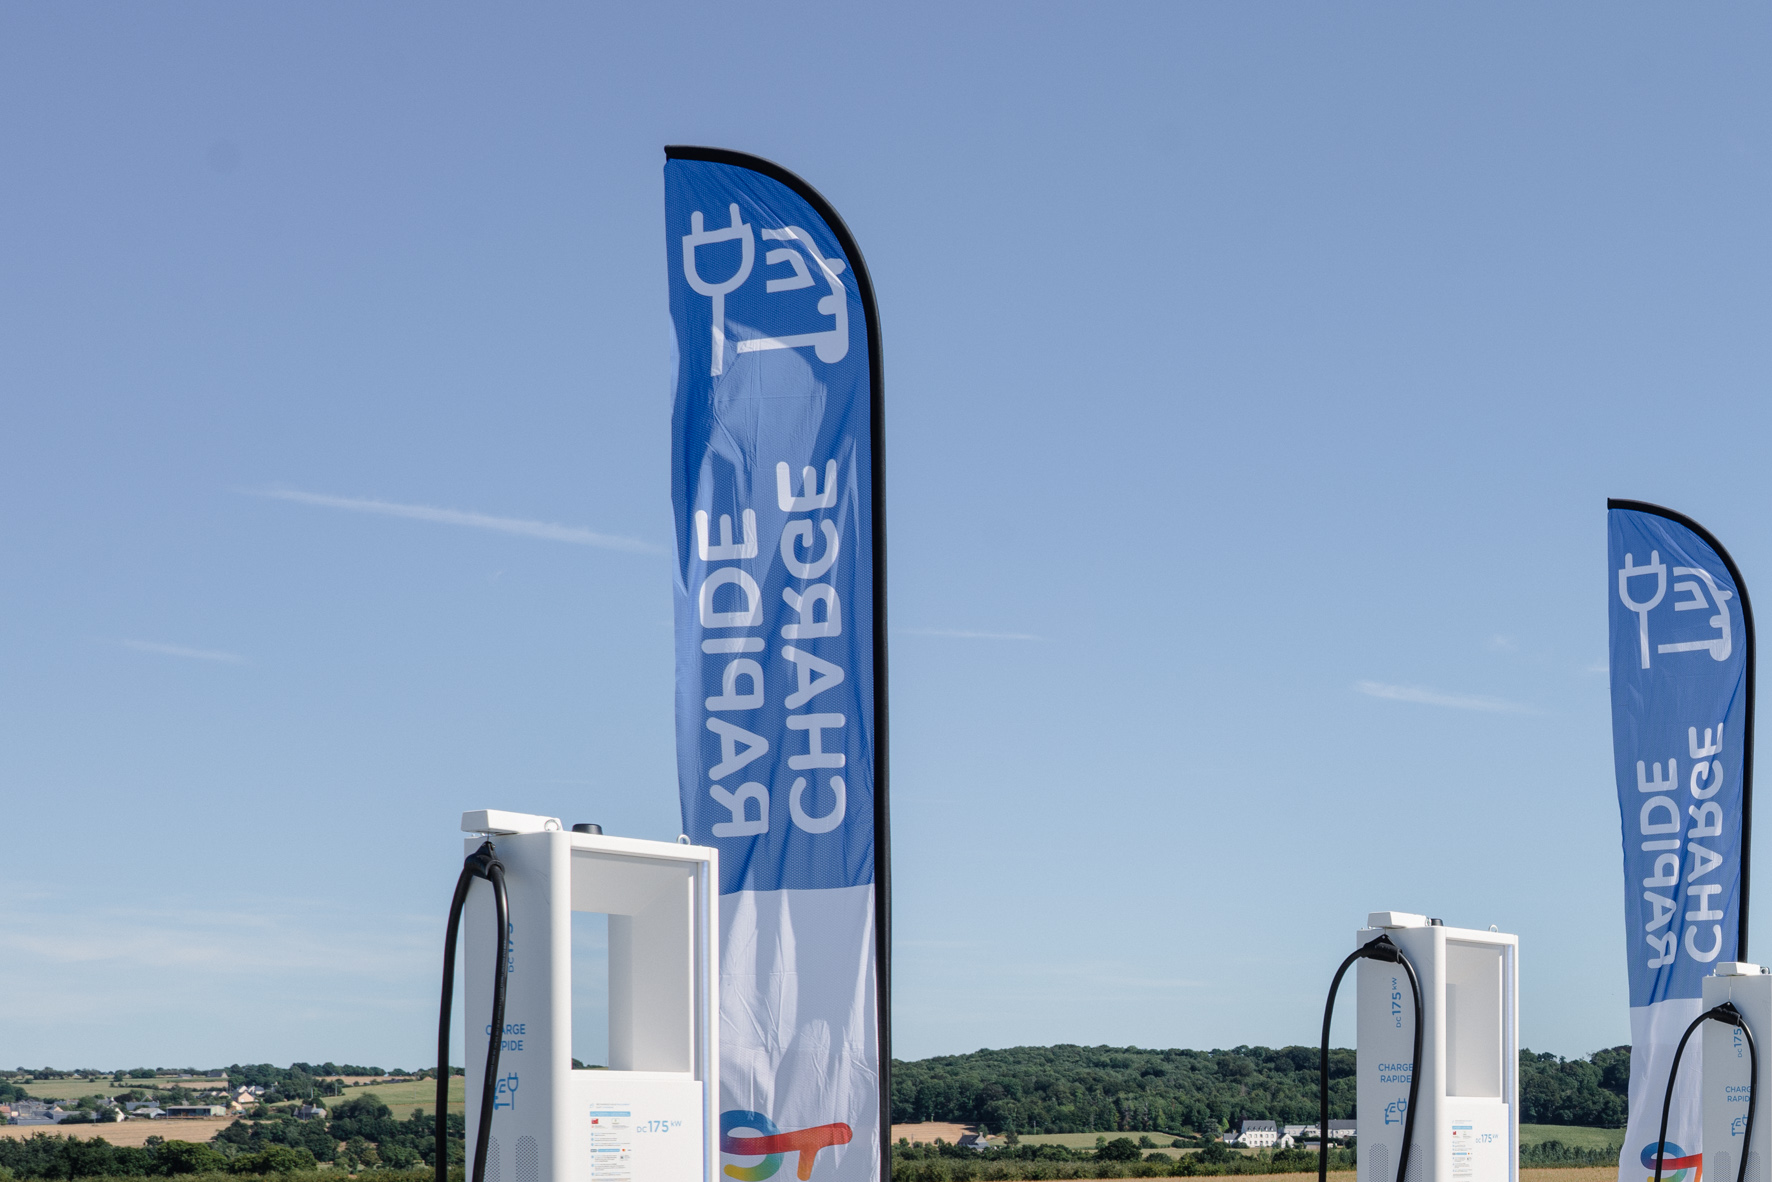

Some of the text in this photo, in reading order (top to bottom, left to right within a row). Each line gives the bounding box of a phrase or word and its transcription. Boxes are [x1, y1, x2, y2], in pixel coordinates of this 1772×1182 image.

[1392, 977, 1402, 1028] DC 175 kW
[486, 1024, 526, 1036] CARGE
[488, 1040, 524, 1051] PIDE
[1734, 1028, 1742, 1058] DC 175
[1378, 1063, 1413, 1072] CHARGE
[1380, 1074, 1412, 1083] RAPIDE
[648, 1120, 669, 1132] 175
[1481, 1134, 1492, 1143] 175
